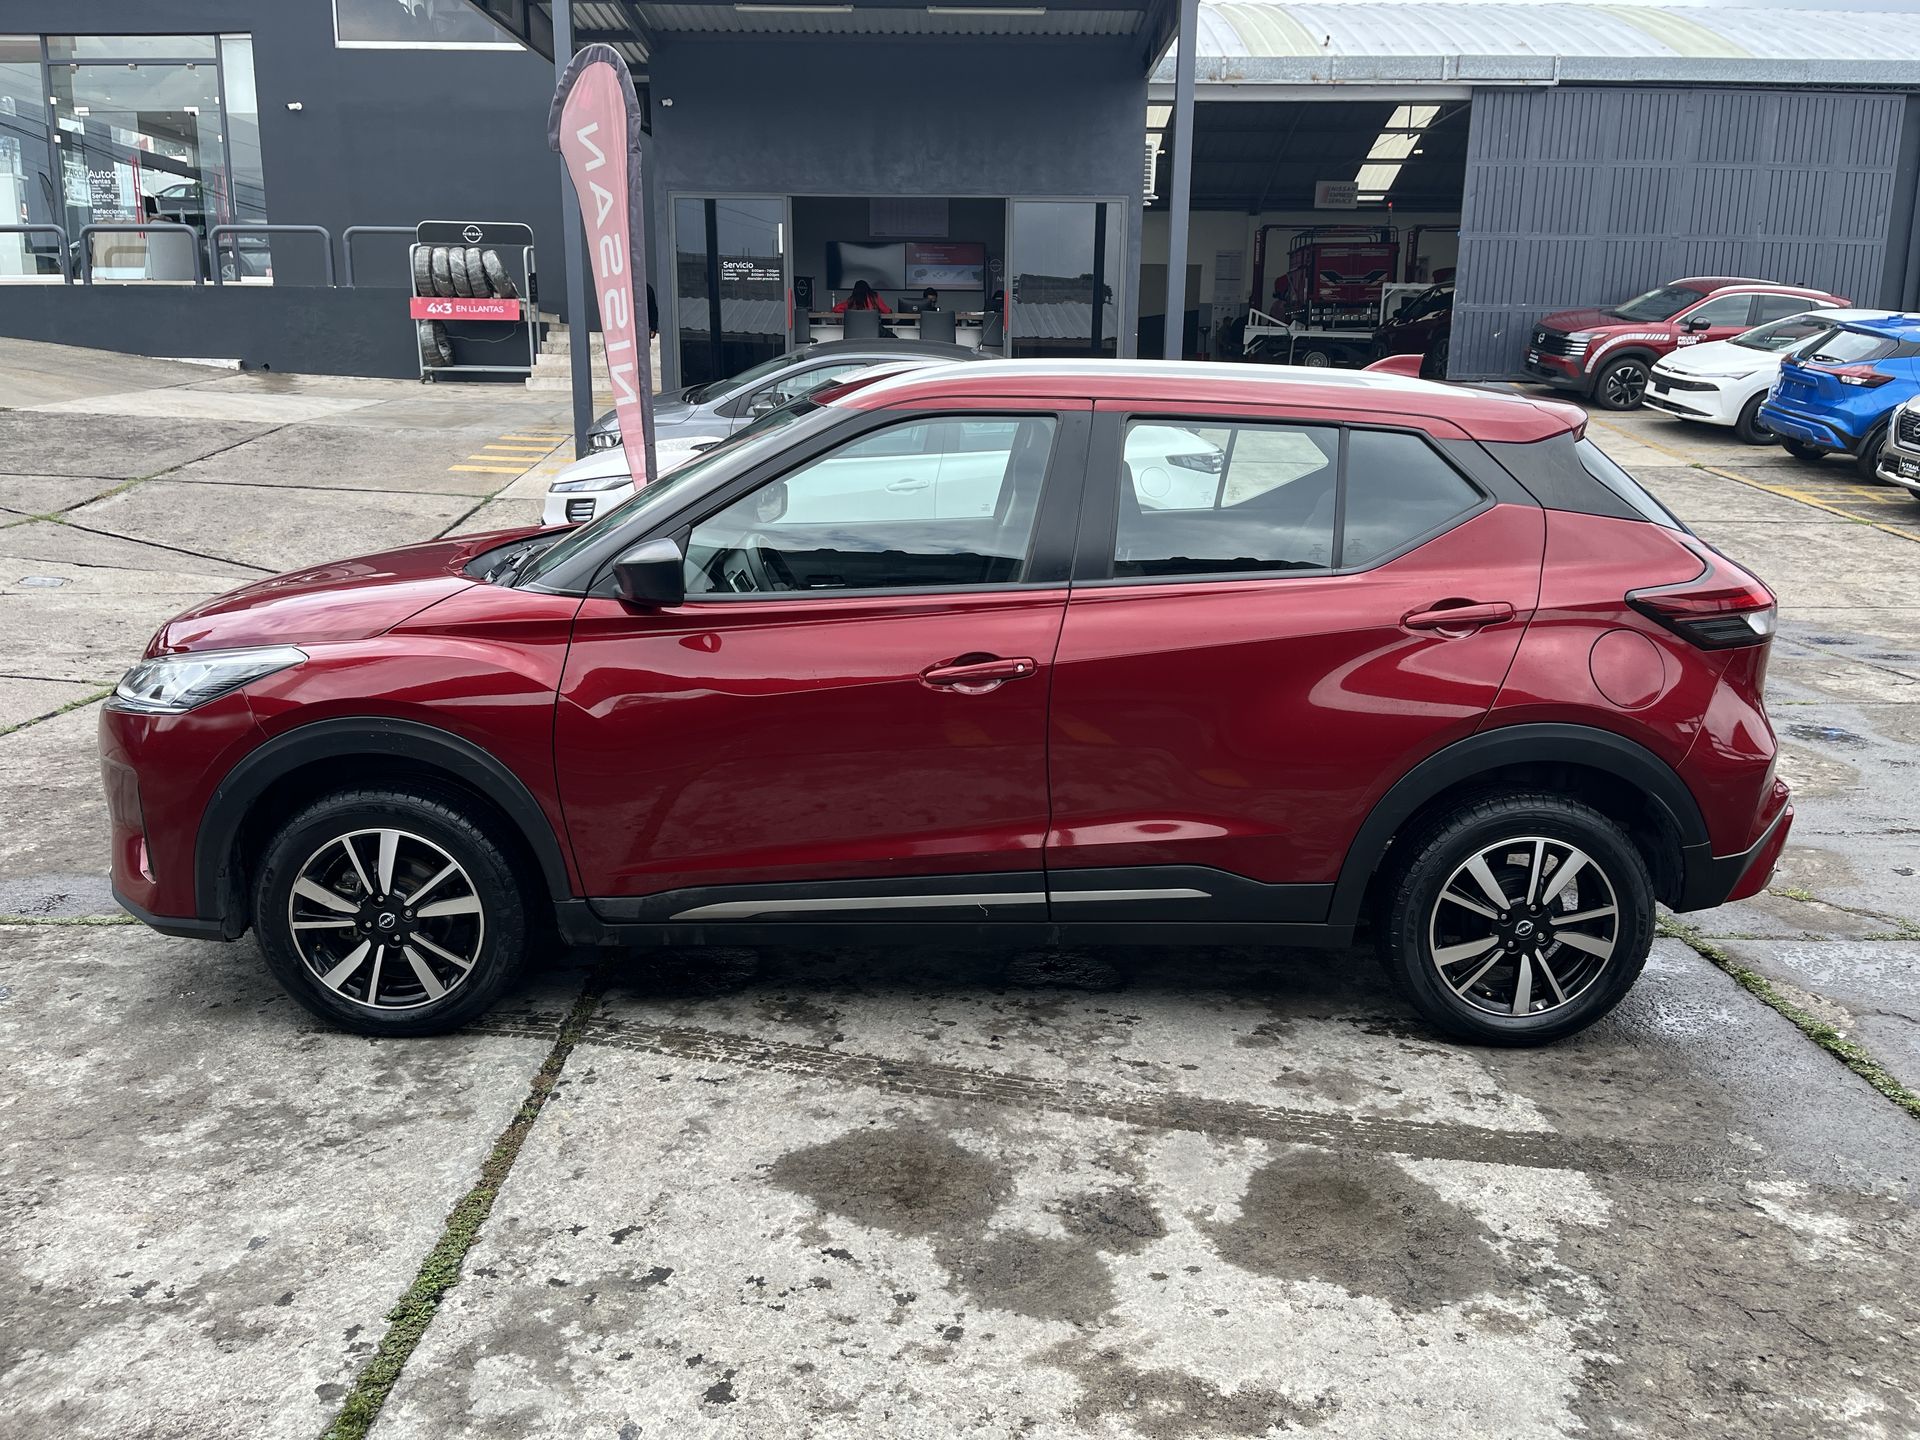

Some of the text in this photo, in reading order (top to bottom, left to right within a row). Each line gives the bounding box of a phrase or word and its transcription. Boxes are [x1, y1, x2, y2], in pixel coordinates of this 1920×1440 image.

[722, 261, 754, 269] Servicio
[426, 302, 453, 314] 4x3
[468, 305, 504, 313] LLANTAS
